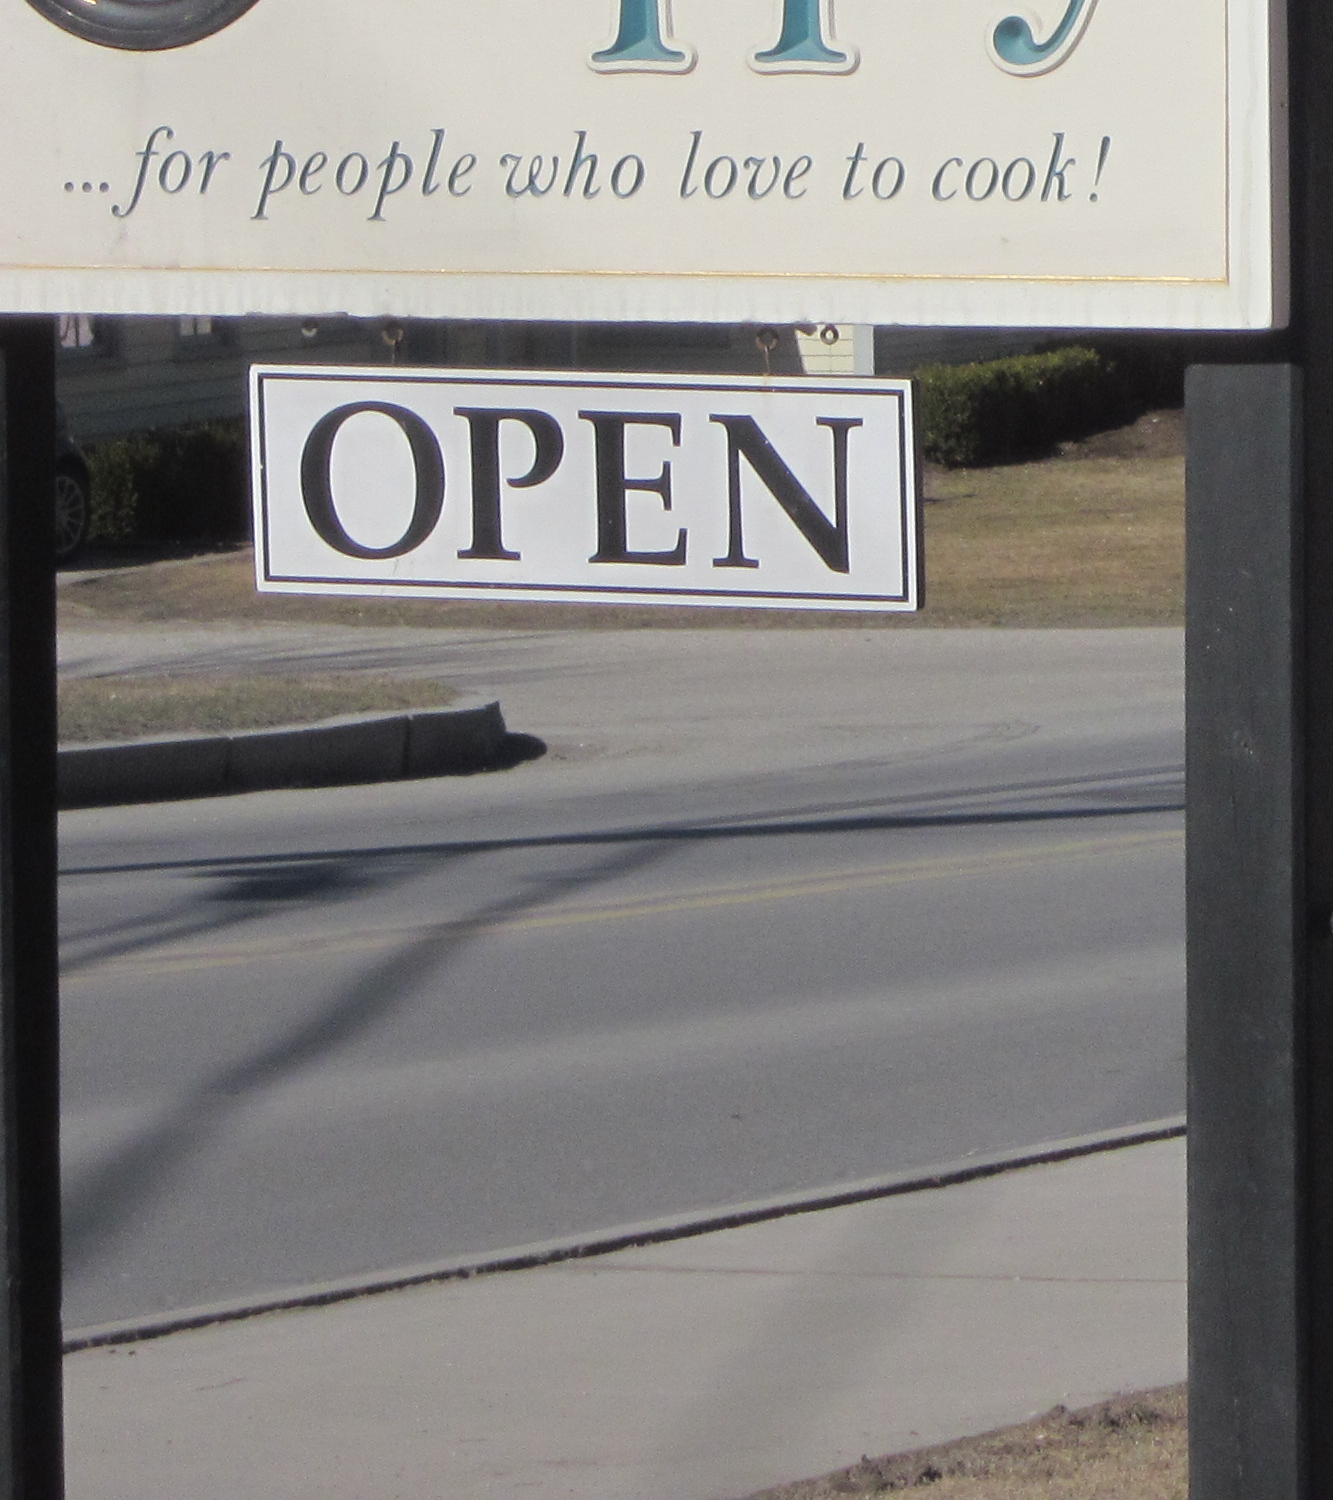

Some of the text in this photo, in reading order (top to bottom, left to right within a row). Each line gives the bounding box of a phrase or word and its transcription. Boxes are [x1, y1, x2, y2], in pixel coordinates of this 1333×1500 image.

[250, 128, 477, 222] people
[499, 130, 645, 200] who
[679, 130, 813, 200] love
[842, 142, 905, 200] to
[931, 132, 1111, 202] cook!
[299, 400, 863, 575] OPEN
